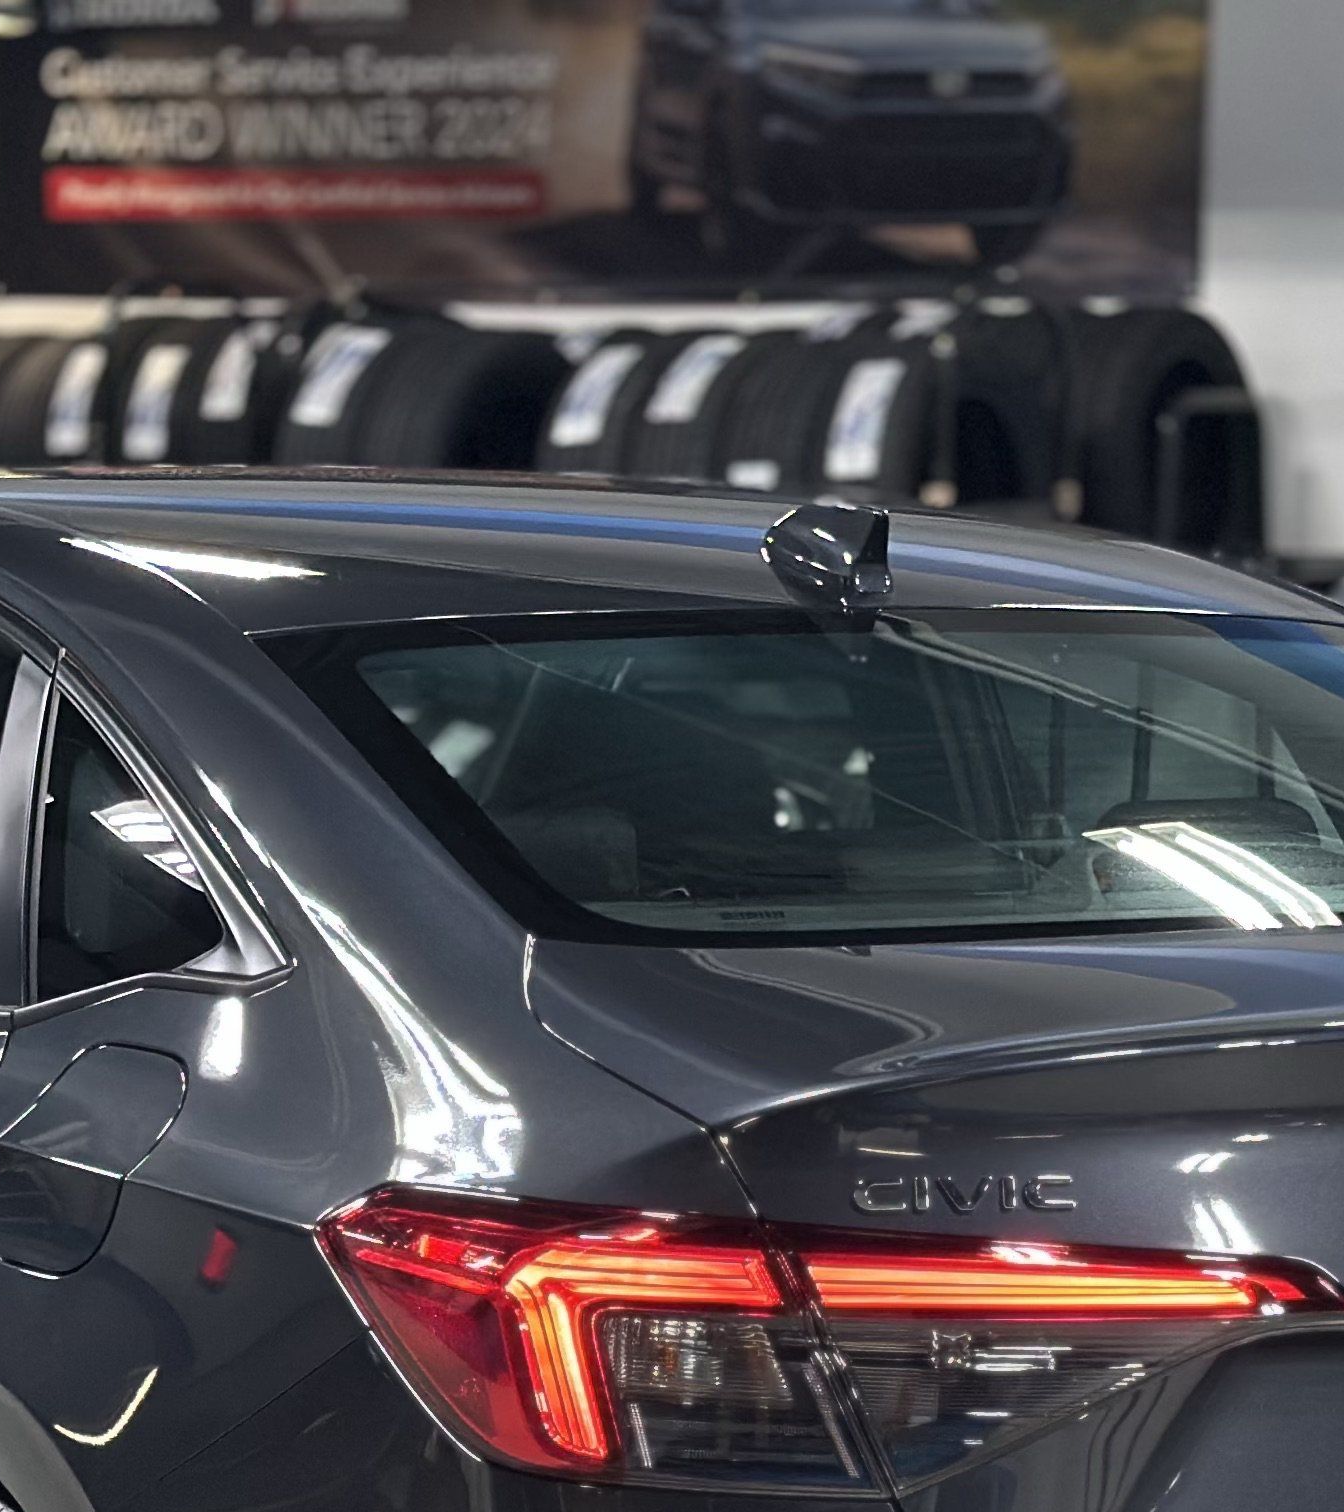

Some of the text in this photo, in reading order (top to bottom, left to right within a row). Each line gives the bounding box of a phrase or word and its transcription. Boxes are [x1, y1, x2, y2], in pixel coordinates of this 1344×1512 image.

[217, 46, 338, 95] Service
[42, 104, 224, 161] AWARD
[228, 101, 427, 159] WINNER
[852, 1174, 1078, 1212] CIVIC
